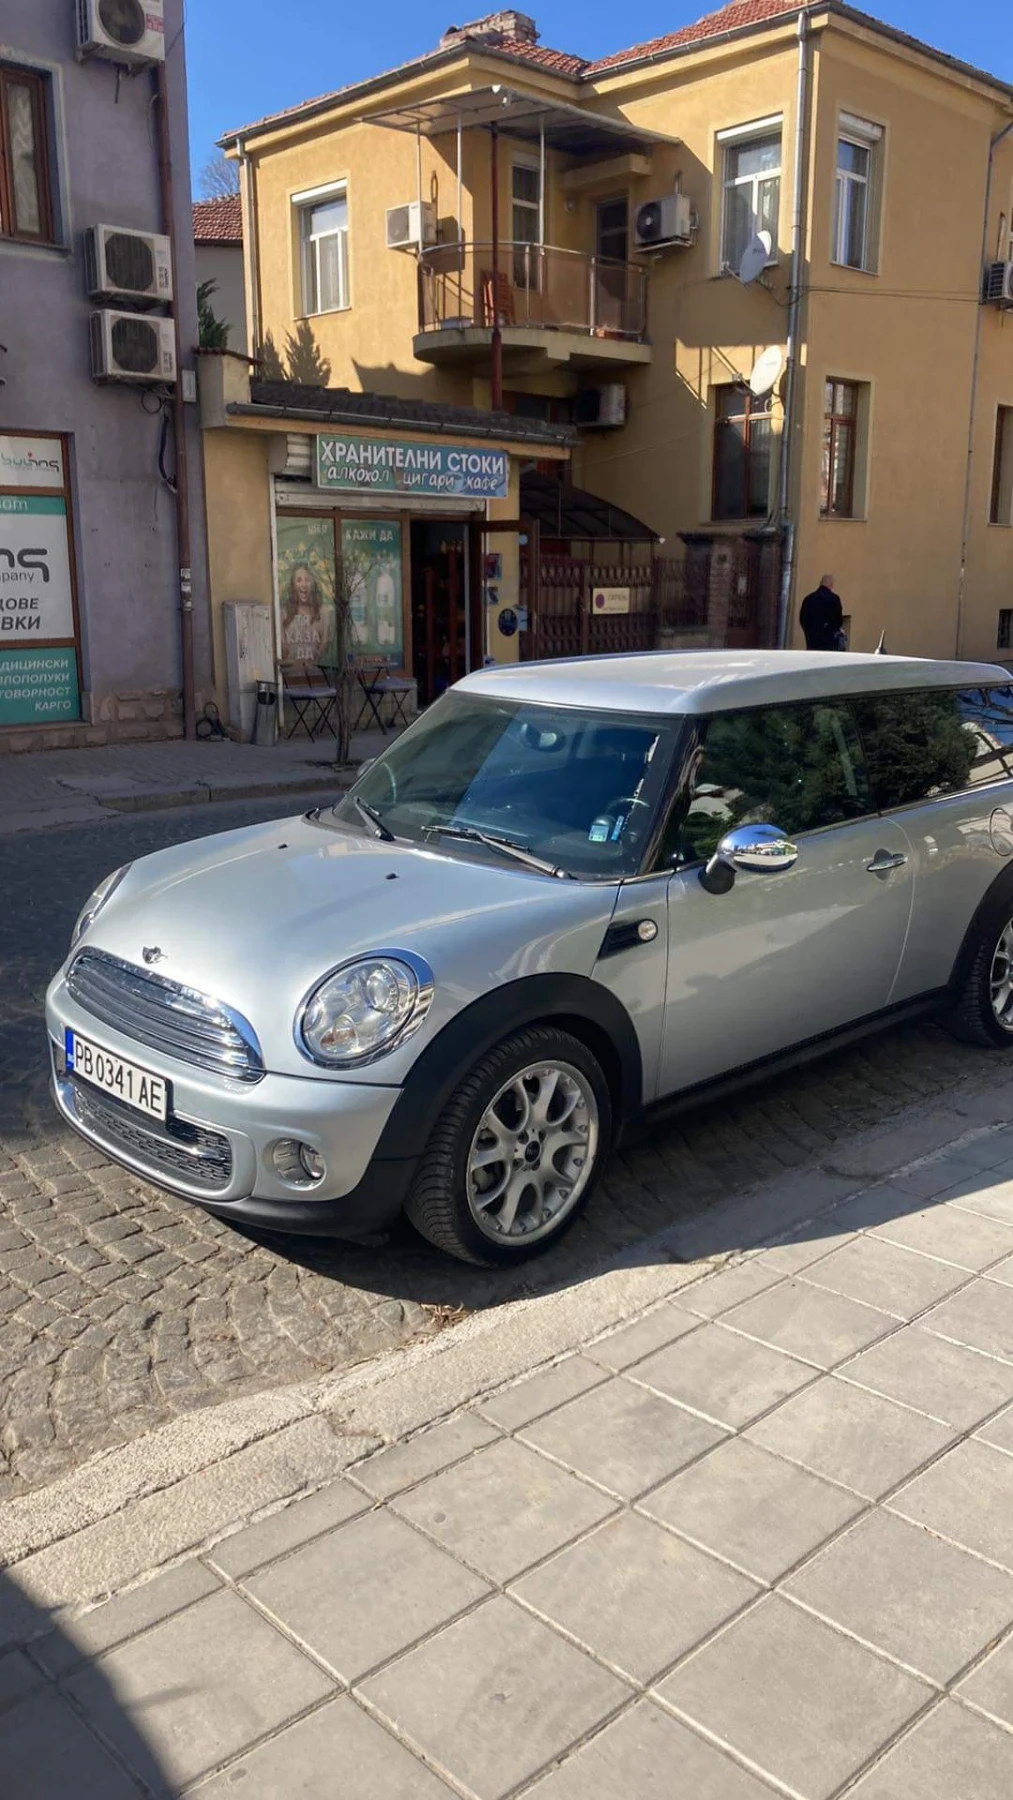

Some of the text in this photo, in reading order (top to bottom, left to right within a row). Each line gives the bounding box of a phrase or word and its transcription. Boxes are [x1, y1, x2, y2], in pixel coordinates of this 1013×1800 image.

[321, 441, 504, 475] ХРАНИТЕЛНИ СТОКИ
[403, 472, 455, 491] цигари
[0, 499, 28, 511] om
[0, 571, 34, 583] pany
[35, 700, 72, 711] КАРГО
[76, 1040, 162, 1114] PB 0341 AE
